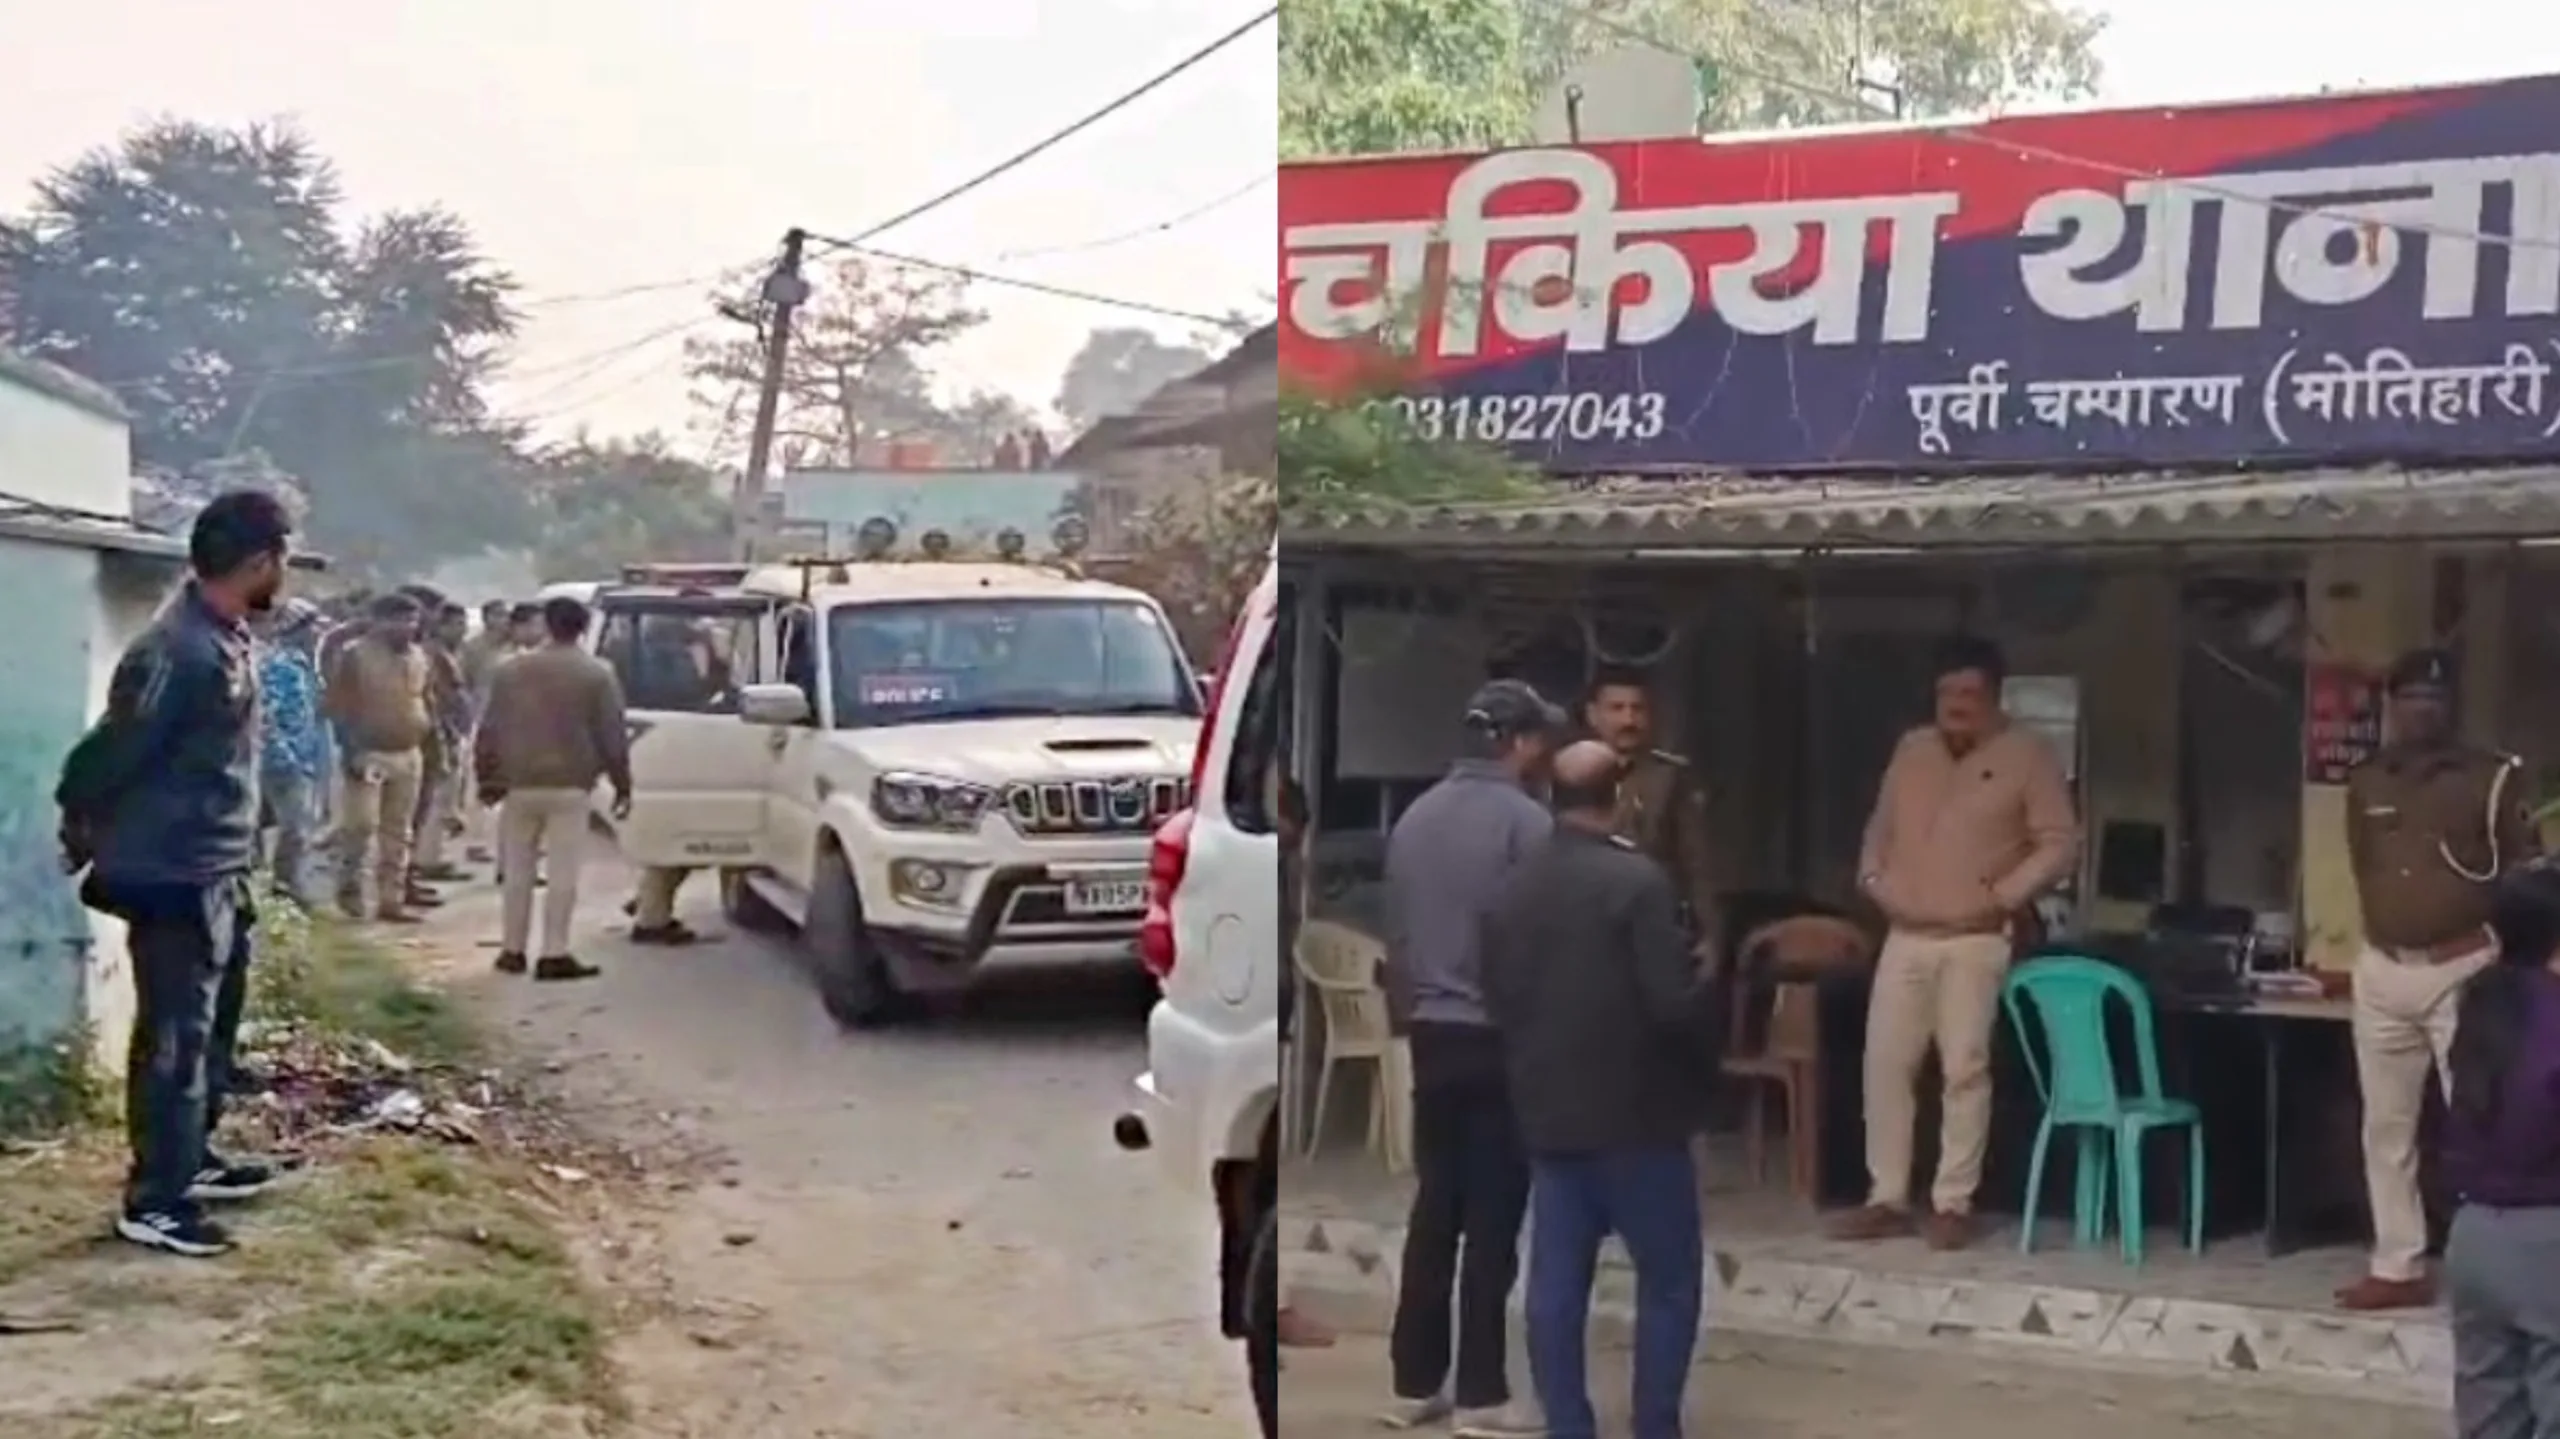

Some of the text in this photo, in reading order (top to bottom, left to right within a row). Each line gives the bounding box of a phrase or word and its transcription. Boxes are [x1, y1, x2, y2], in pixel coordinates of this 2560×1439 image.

[1285, 149, 2560, 356] चकिया थाना
[1362, 392, 1666, 442] 31827043
[1908, 360, 2008, 453] पूर्वी
[2026, 374, 2242, 428] चम्पारण
